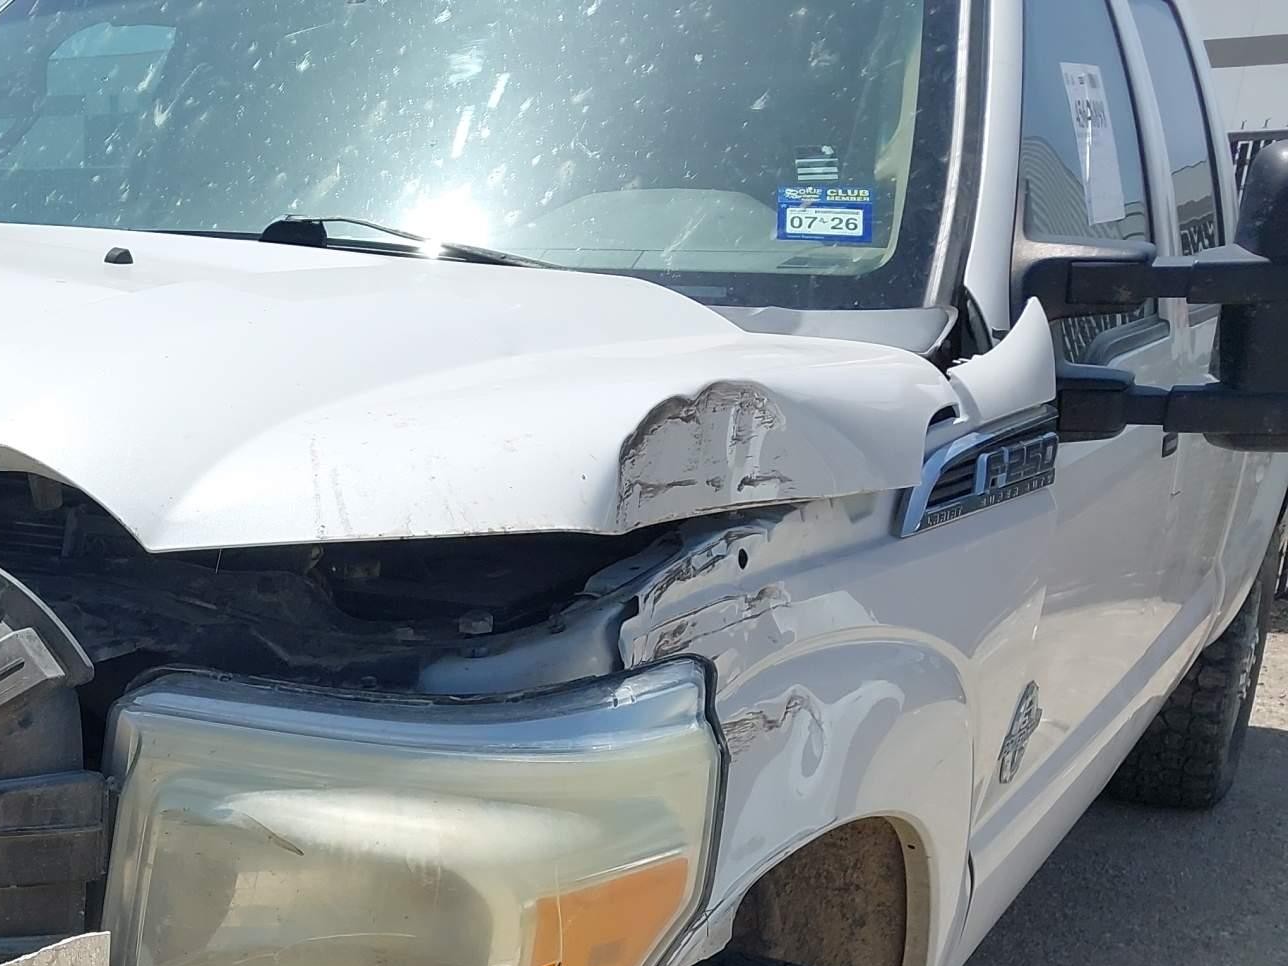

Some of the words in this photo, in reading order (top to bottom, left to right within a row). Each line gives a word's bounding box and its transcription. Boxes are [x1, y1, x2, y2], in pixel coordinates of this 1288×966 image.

[826, 188, 870, 197] CLUB
[790, 215, 818, 230] 07
[830, 217, 859, 231] 26
